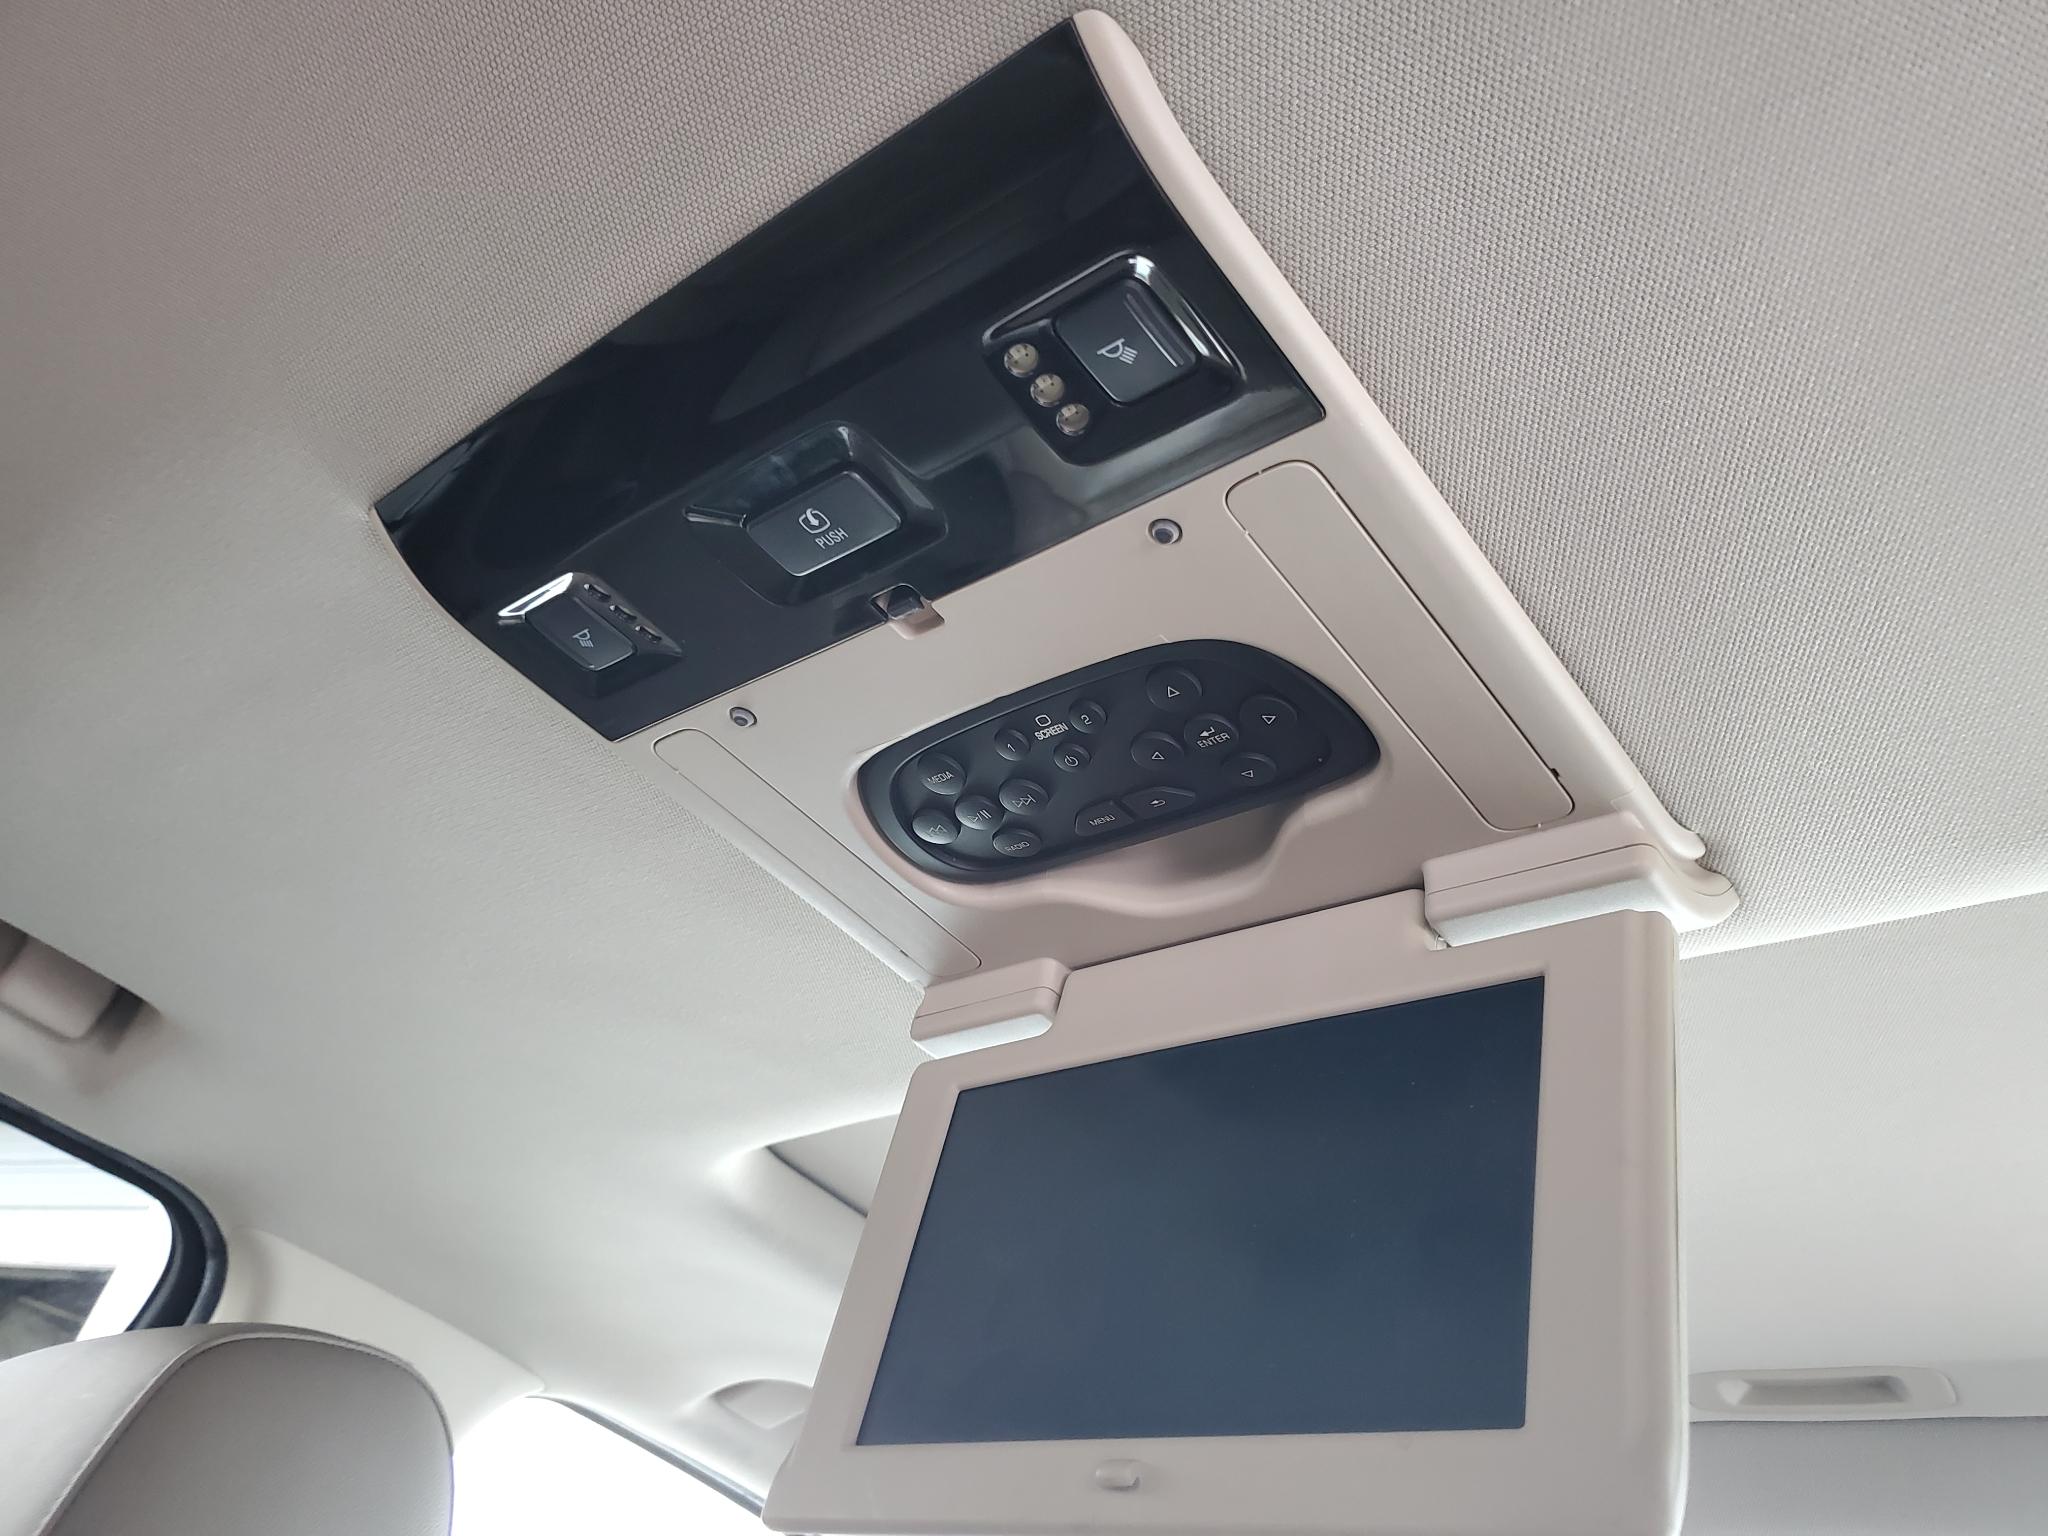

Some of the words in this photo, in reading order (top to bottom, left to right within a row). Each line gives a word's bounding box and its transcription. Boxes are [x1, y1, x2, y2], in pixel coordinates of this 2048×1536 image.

[815, 527, 849, 550] PUSH
[1080, 714, 1092, 725] 2
[1034, 722, 1069, 741] SCREEN
[1196, 732, 1231, 749] ENTER
[1007, 743, 1016, 752] 1
[927, 771, 954, 784] MEDIA
[1089, 815, 1116, 827] MENU
[1004, 841, 1030, 851] RADIO
